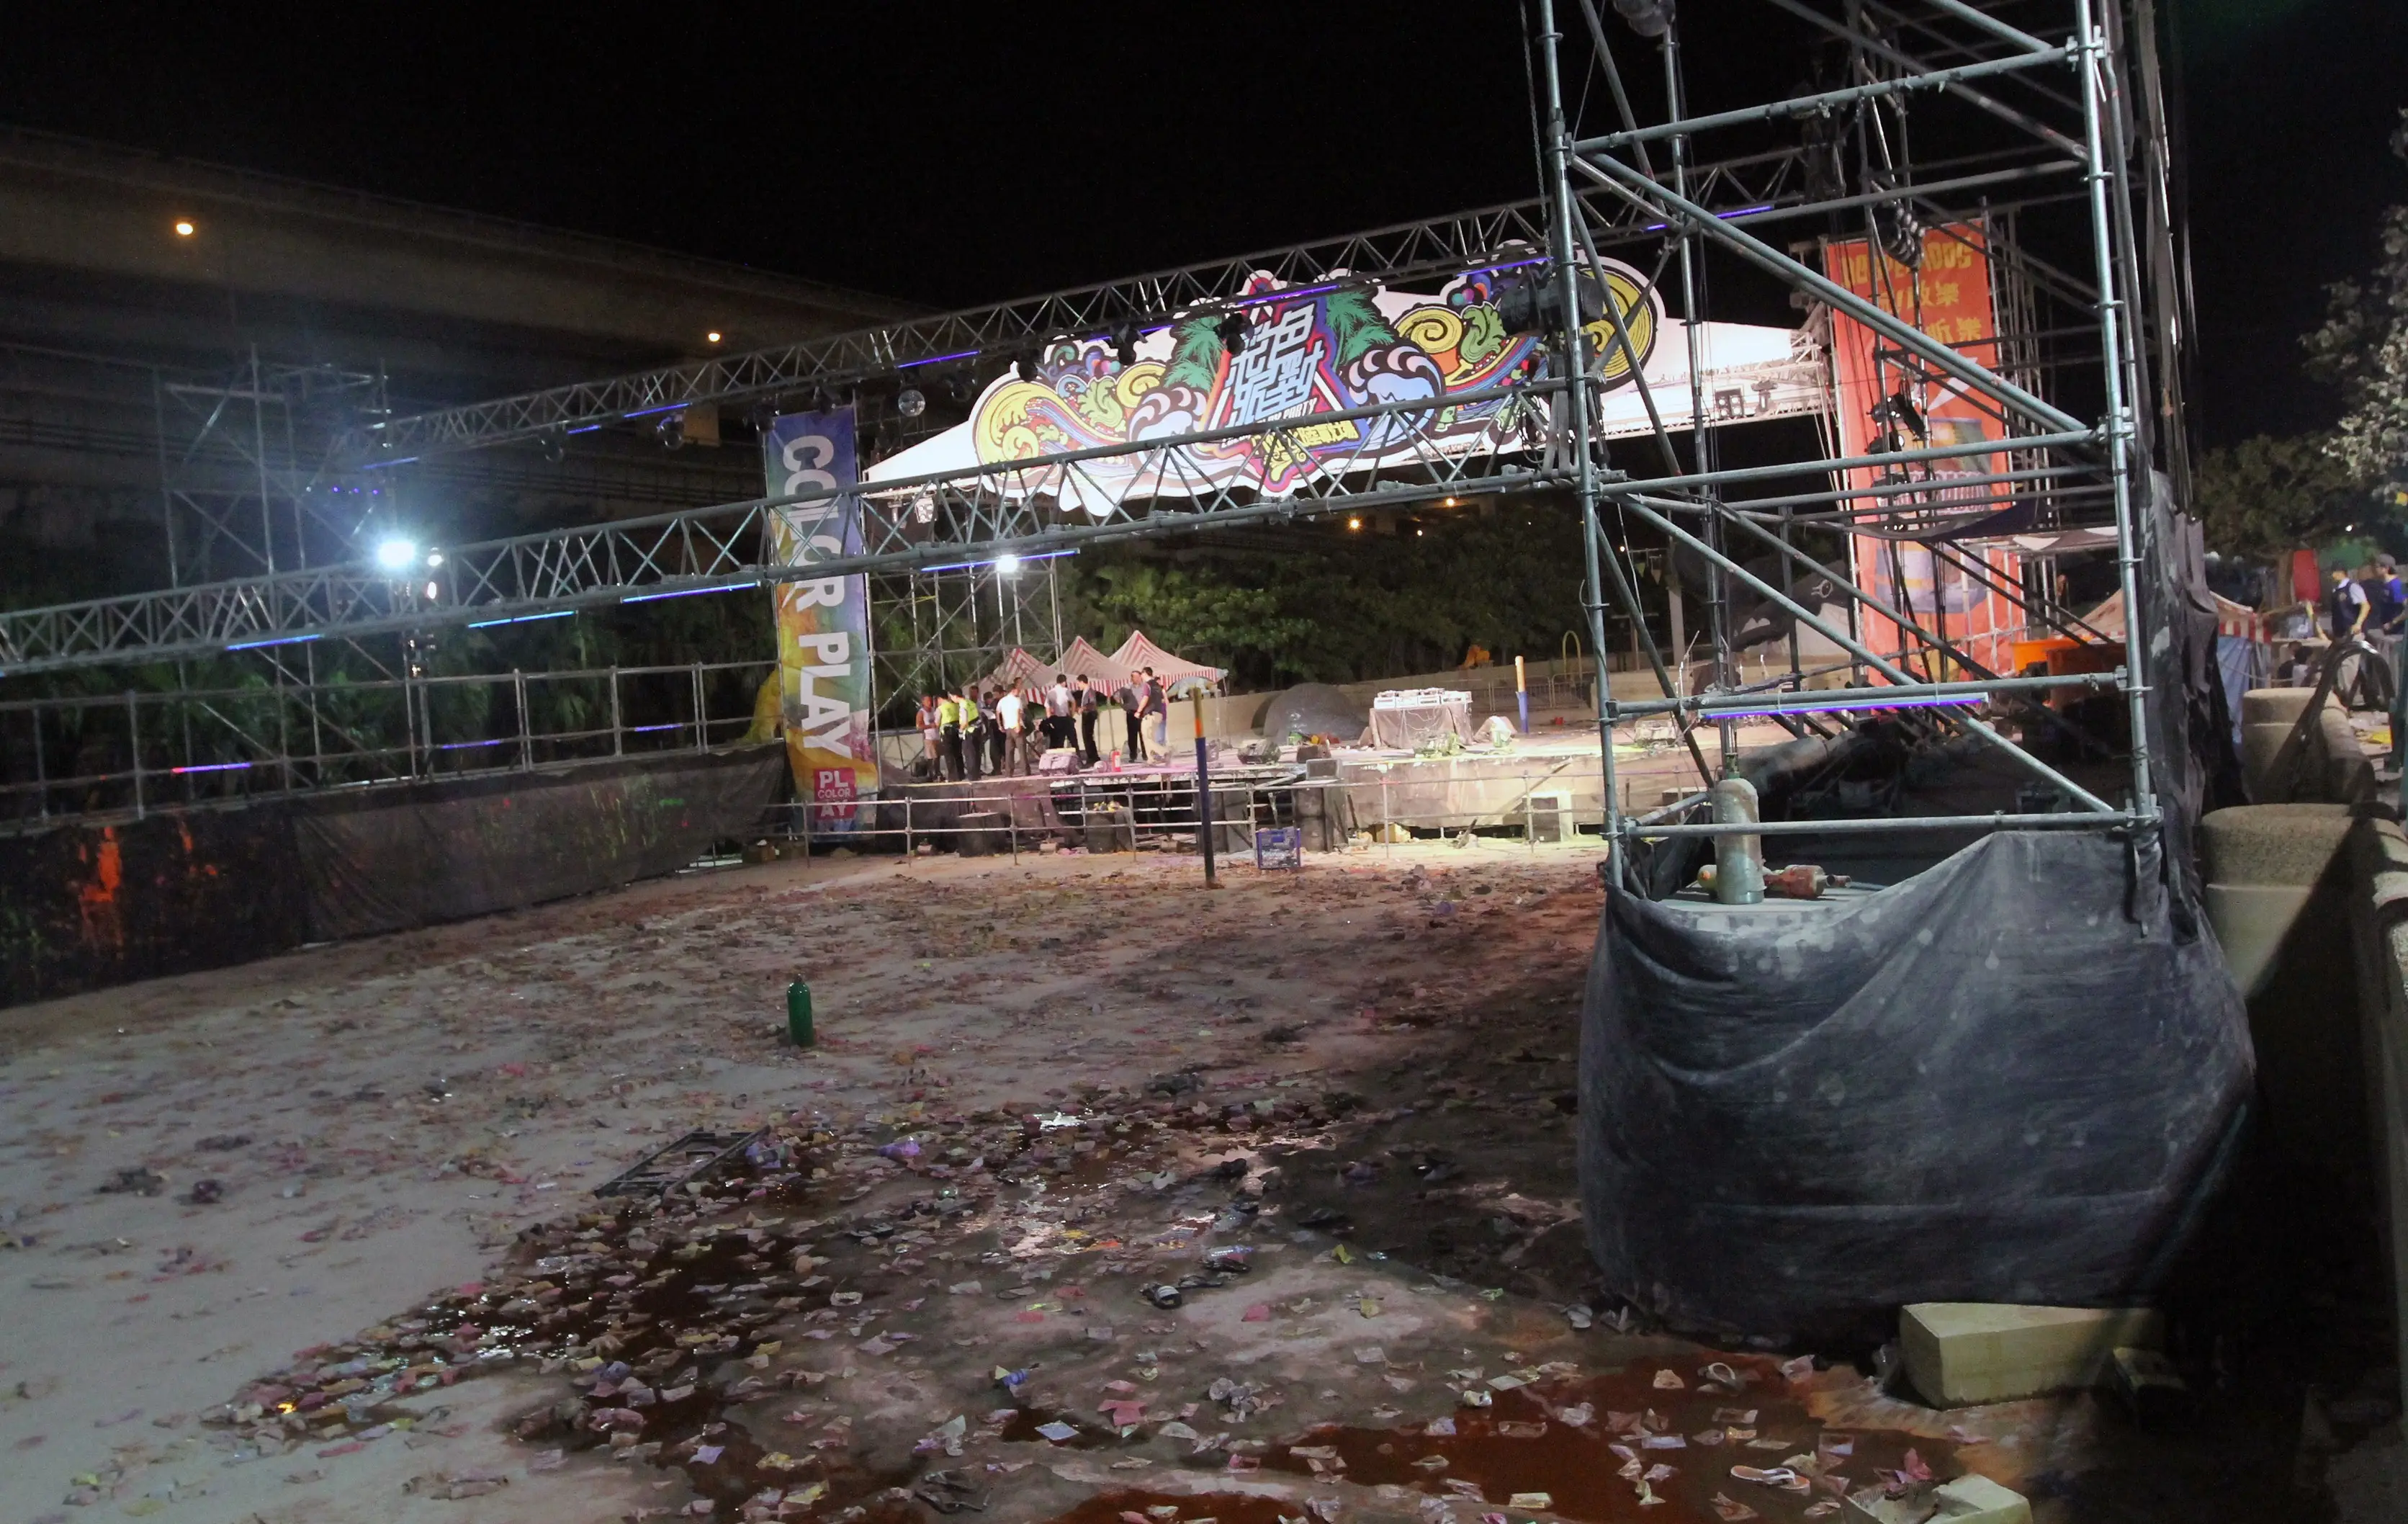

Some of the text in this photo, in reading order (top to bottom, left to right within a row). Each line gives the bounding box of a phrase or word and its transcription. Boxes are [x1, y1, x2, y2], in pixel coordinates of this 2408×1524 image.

[1282, 397, 1317, 420] PARTY
[783, 435, 853, 759] COLOR PLAY
[819, 771, 848, 789] PL
[818, 788, 854, 799] COLOR
